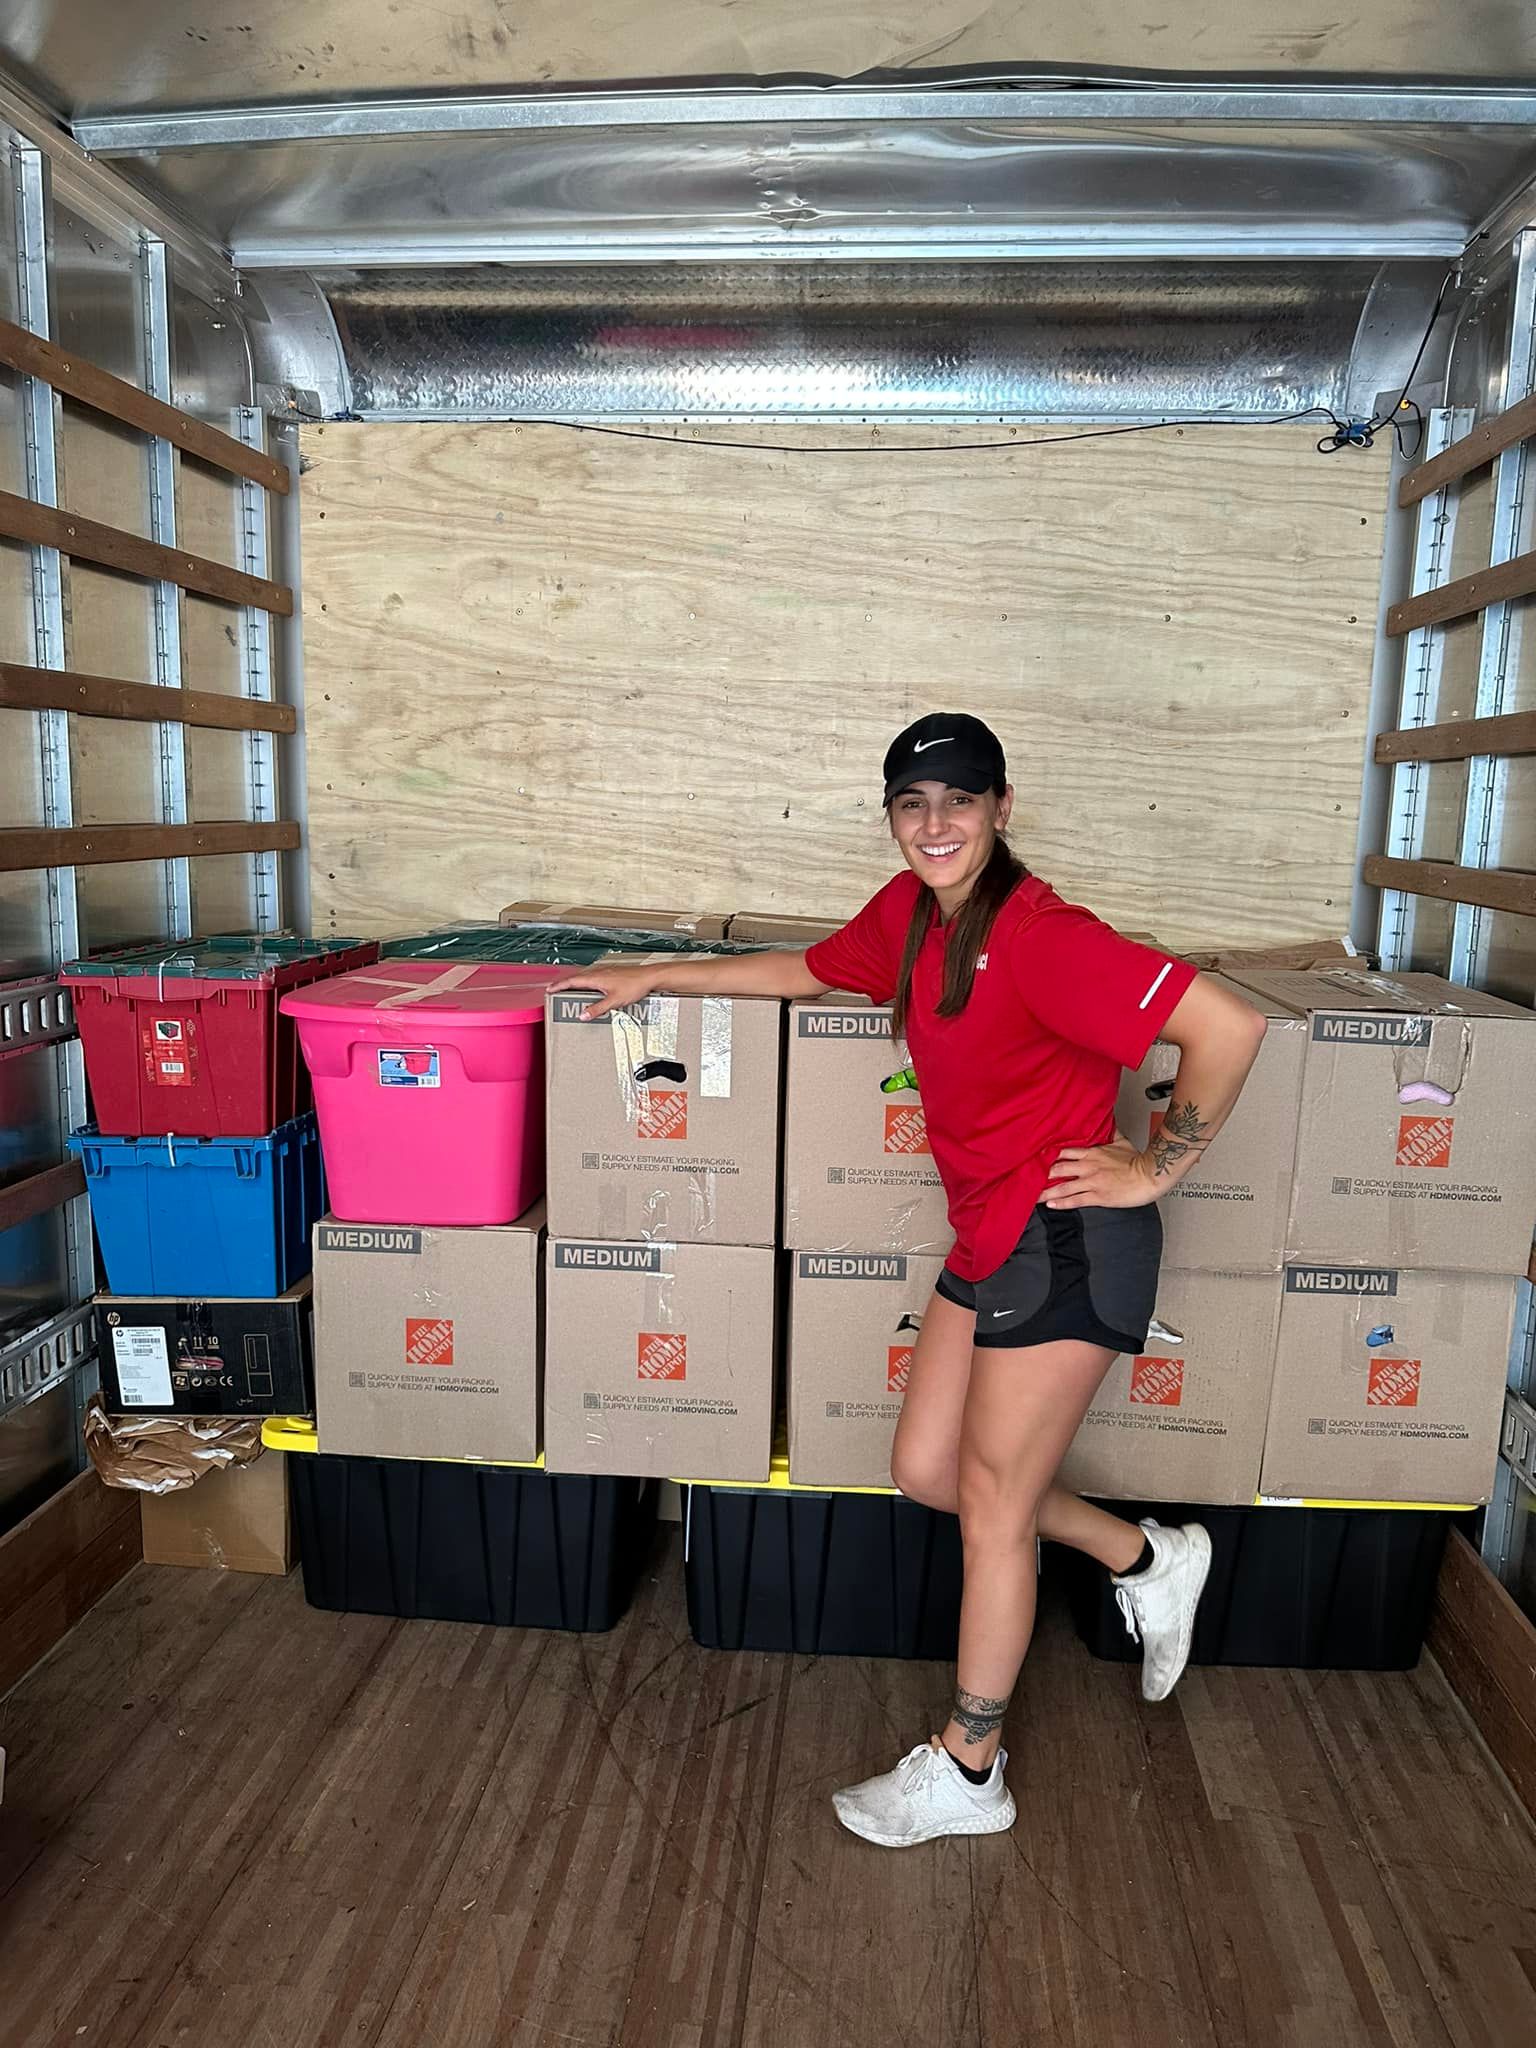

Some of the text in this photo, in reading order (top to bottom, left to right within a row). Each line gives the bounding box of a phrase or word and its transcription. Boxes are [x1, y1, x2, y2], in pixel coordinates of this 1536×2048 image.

[1323, 1020, 1423, 1041] MEDIUM
[638, 1091, 686, 1137] HOME
[890, 1109, 912, 1129] THE
[657, 1109, 686, 1138] DEPOT
[885, 1107, 927, 1153] HOM
[1404, 1121, 1427, 1140] THE
[1396, 1116, 1453, 1165] HOME
[602, 1153, 735, 1166] QUICKLY ESTIMATE YOUR PACKING
[1417, 1136, 1451, 1166] DEPOT
[602, 1163, 632, 1172] SUPPLY
[633, 1164, 660, 1173] NEEDS
[661, 1165, 671, 1173] AT
[847, 1168, 881, 1177] QUICKLY
[884, 1169, 922, 1178] ESTIMATE
[847, 1177, 878, 1186] SUPPLY
[879, 1178, 907, 1187] NEEDS
[908, 1179, 919, 1187] AT
[1187, 1183, 1211, 1192] YOUR
[1212, 1184, 1250, 1193] PACKING
[1354, 1179, 1497, 1194] QUICKLY ESTIMATE YOUR PACKING
[1181, 1191, 1254, 1201] HDMOVING.COM
[1353, 1187, 1502, 1202] SUPPLY NEEDS AT HDMOVING.COM
[326, 1231, 413, 1249] MEDIUM
[563, 1248, 652, 1267] MEDIUM
[808, 1258, 898, 1276] MEDIUM
[1295, 1272, 1389, 1291] MEDIUM
[406, 1319, 454, 1364] HOME
[412, 1324, 430, 1341] THE
[425, 1338, 453, 1364] DEPOT
[643, 1337, 664, 1357] THE
[638, 1334, 687, 1379] HOME
[657, 1351, 686, 1379] DEPOT
[367, 1373, 494, 1386] QUICKLY ESTIMATE YOUR PACKING
[1137, 1362, 1159, 1380] THE
[1375, 1364, 1397, 1382] THE
[367, 1382, 499, 1394] SUPPLY NEEDS AT HDMOVING.COM
[1131, 1359, 1184, 1402] HOME
[1367, 1360, 1421, 1405] HOME
[1151, 1377, 1183, 1403] DEPOT
[1387, 1377, 1419, 1405] DEPOT
[602, 1394, 733, 1407] QUICKLY ESTIMATE YOUR PACKING
[602, 1403, 738, 1415] SUPPLY NEEDS AT HDMOVING.COM
[845, 1402, 879, 1411] QUICKLY
[845, 1411, 899, 1420] SUPPLY NEED
[1087, 1409, 1223, 1427] QUICKLY ESTIMATE YOUR PACKING
[1085, 1417, 1227, 1435] SUPPLY NEEDS AT HDMOVING.COM
[1328, 1420, 1464, 1432] QUICKLY ESTIMATE YOUR PACKING
[1328, 1427, 1469, 1440] SUPPLY NEEDS AT HDMOVING.COM
